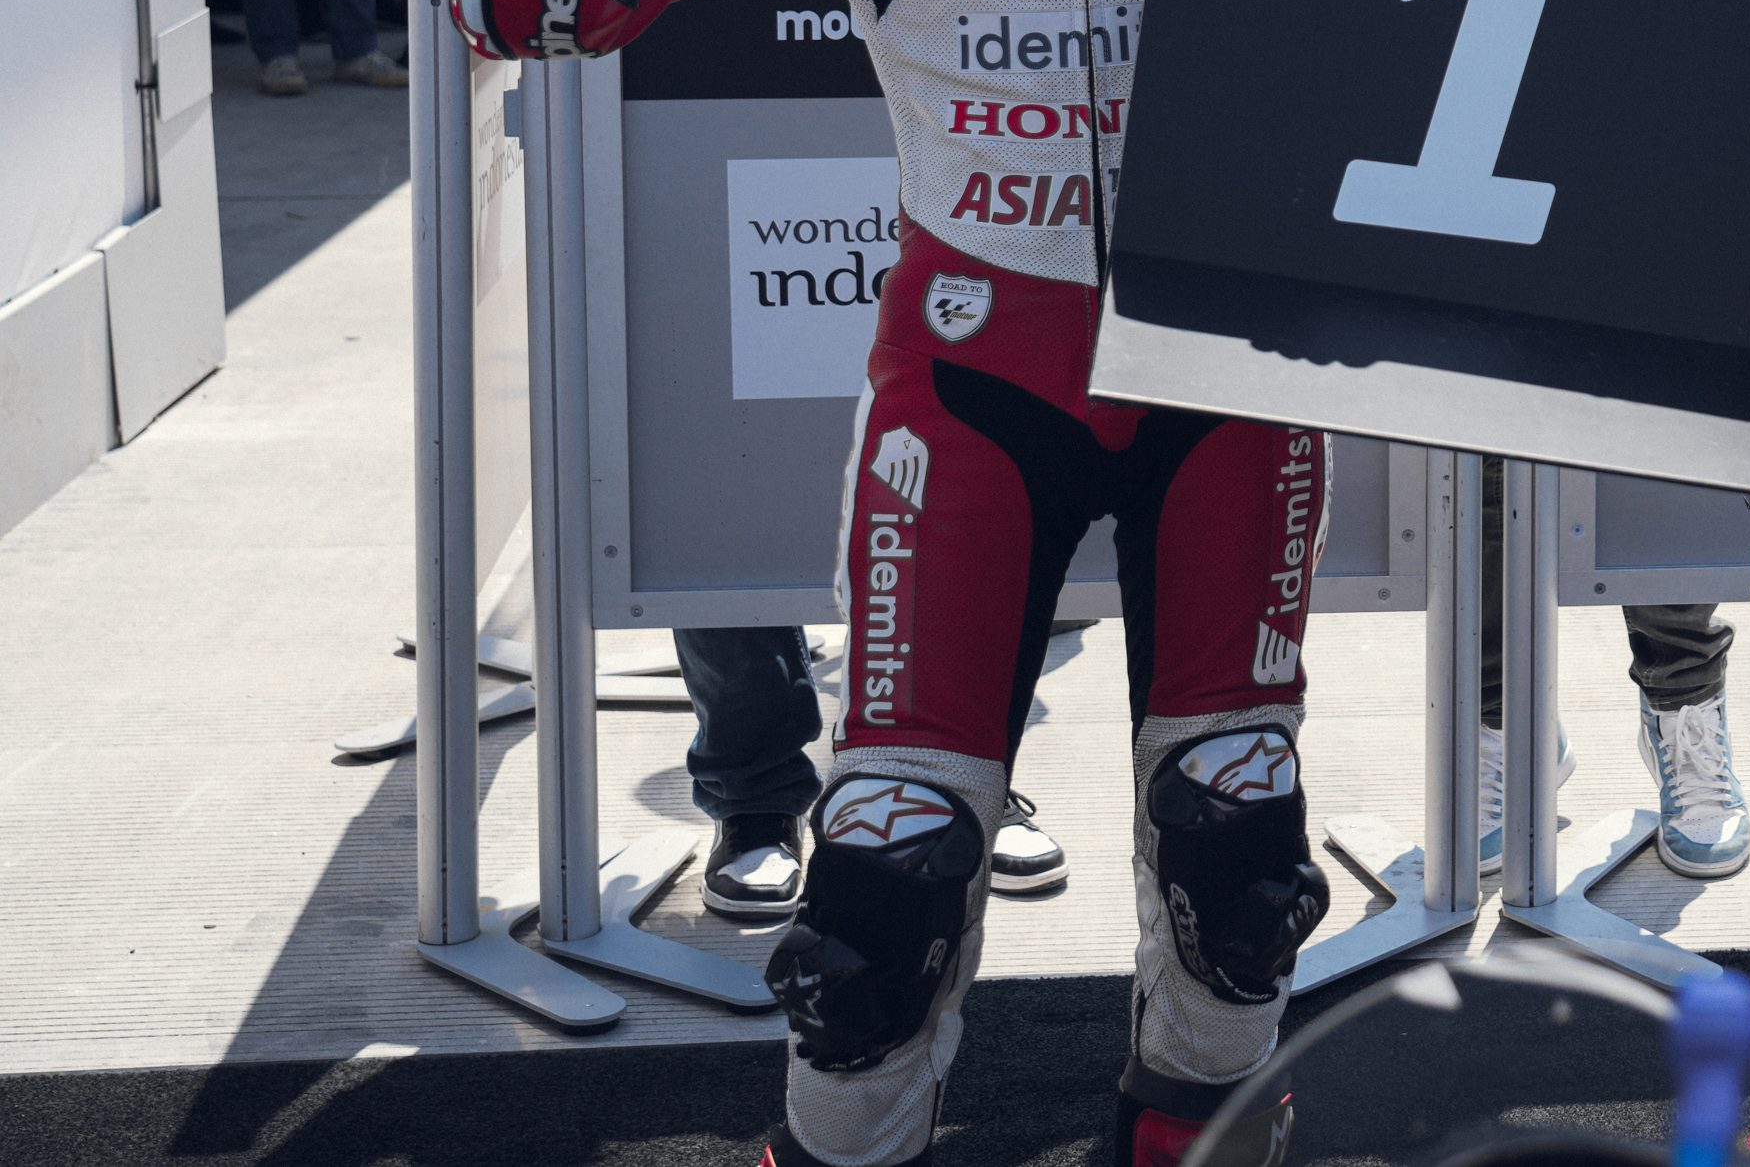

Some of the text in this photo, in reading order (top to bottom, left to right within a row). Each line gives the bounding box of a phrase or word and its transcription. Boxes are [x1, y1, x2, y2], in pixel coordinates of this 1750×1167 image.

[958, 6, 1141, 70] idemi
[948, 99, 1129, 140] HON
[949, 172, 1092, 226] ASIA
[941, 282, 983, 293] ROAD TO
[864, 514, 913, 726] idemitsu
